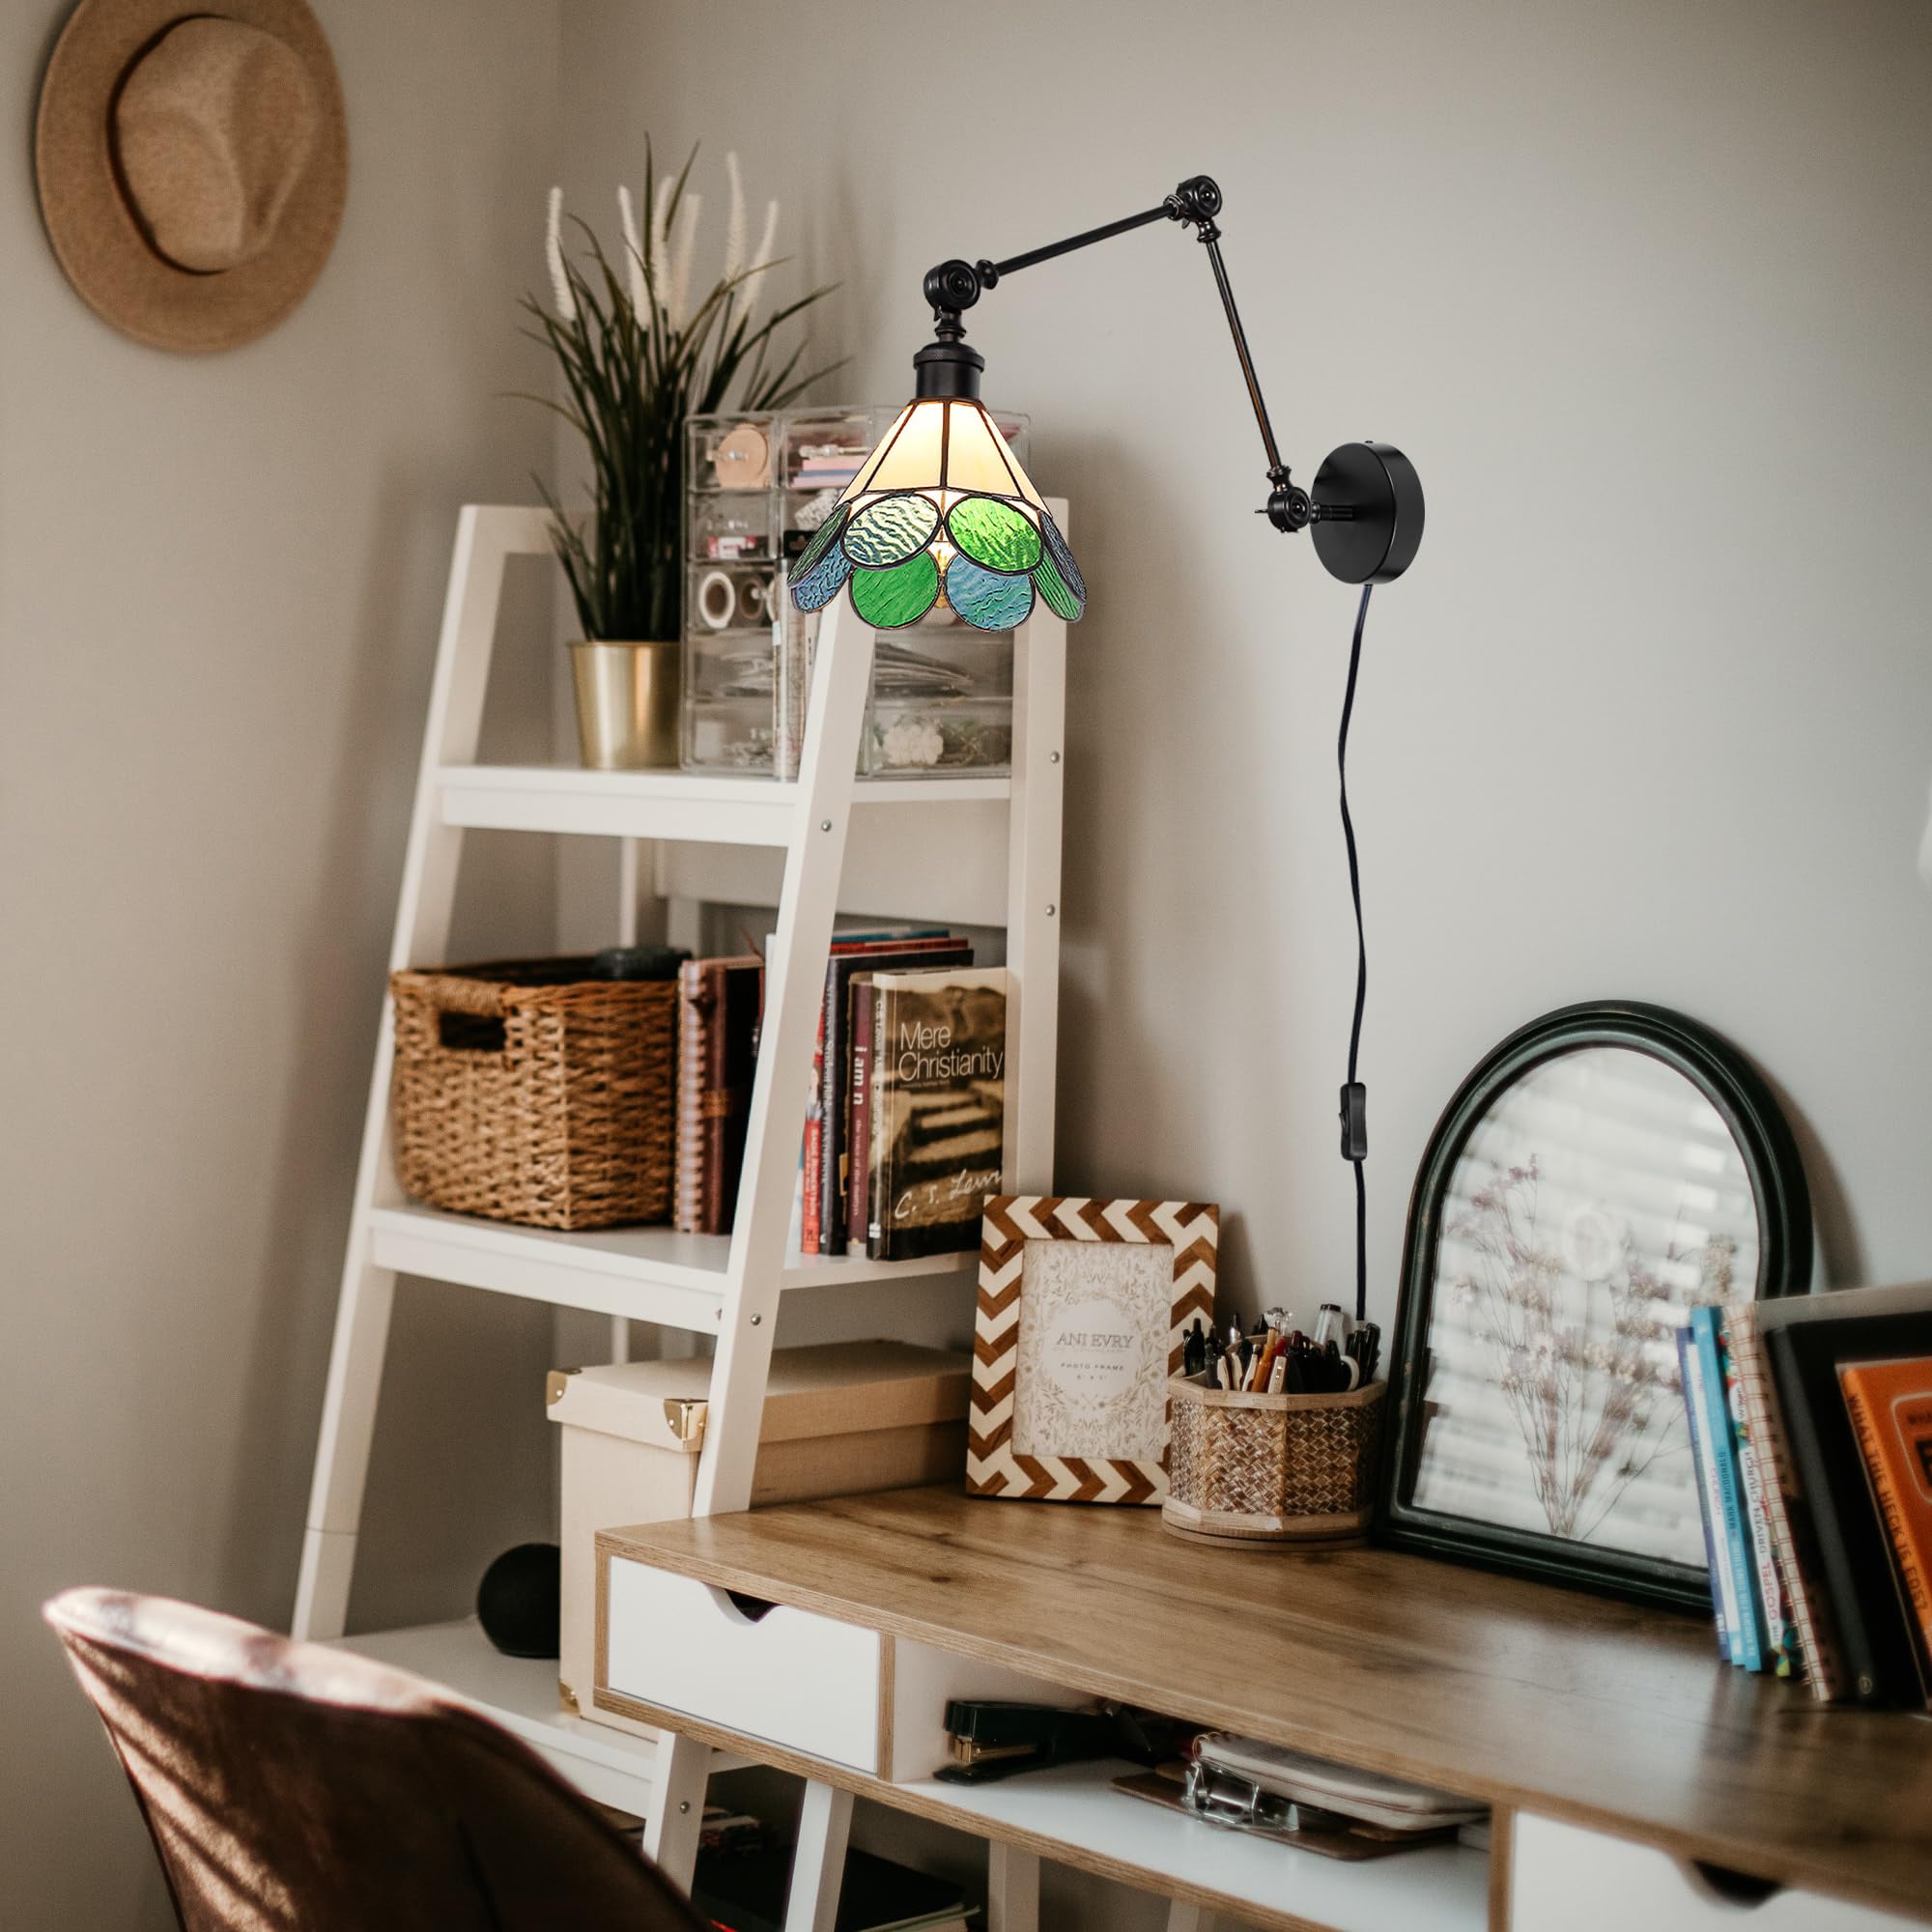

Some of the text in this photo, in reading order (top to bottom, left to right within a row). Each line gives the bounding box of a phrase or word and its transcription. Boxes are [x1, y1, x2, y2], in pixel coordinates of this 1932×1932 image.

[900, 1021, 952, 1052] Mere
[853, 1057, 865, 1087] am
[898, 1046, 1004, 1081] Christianity
[853, 1093, 864, 1105] n
[895, 1190, 918, 1219] C.
[928, 1184, 940, 1206] S.
[1745, 1451, 1761, 1504] CHURCH
[1847, 1395, 1875, 1448] WHAT
[1866, 1452, 1889, 1484] THE
[1882, 1491, 1908, 1537] HECK
[1726, 1505, 1739, 1530] MARK
